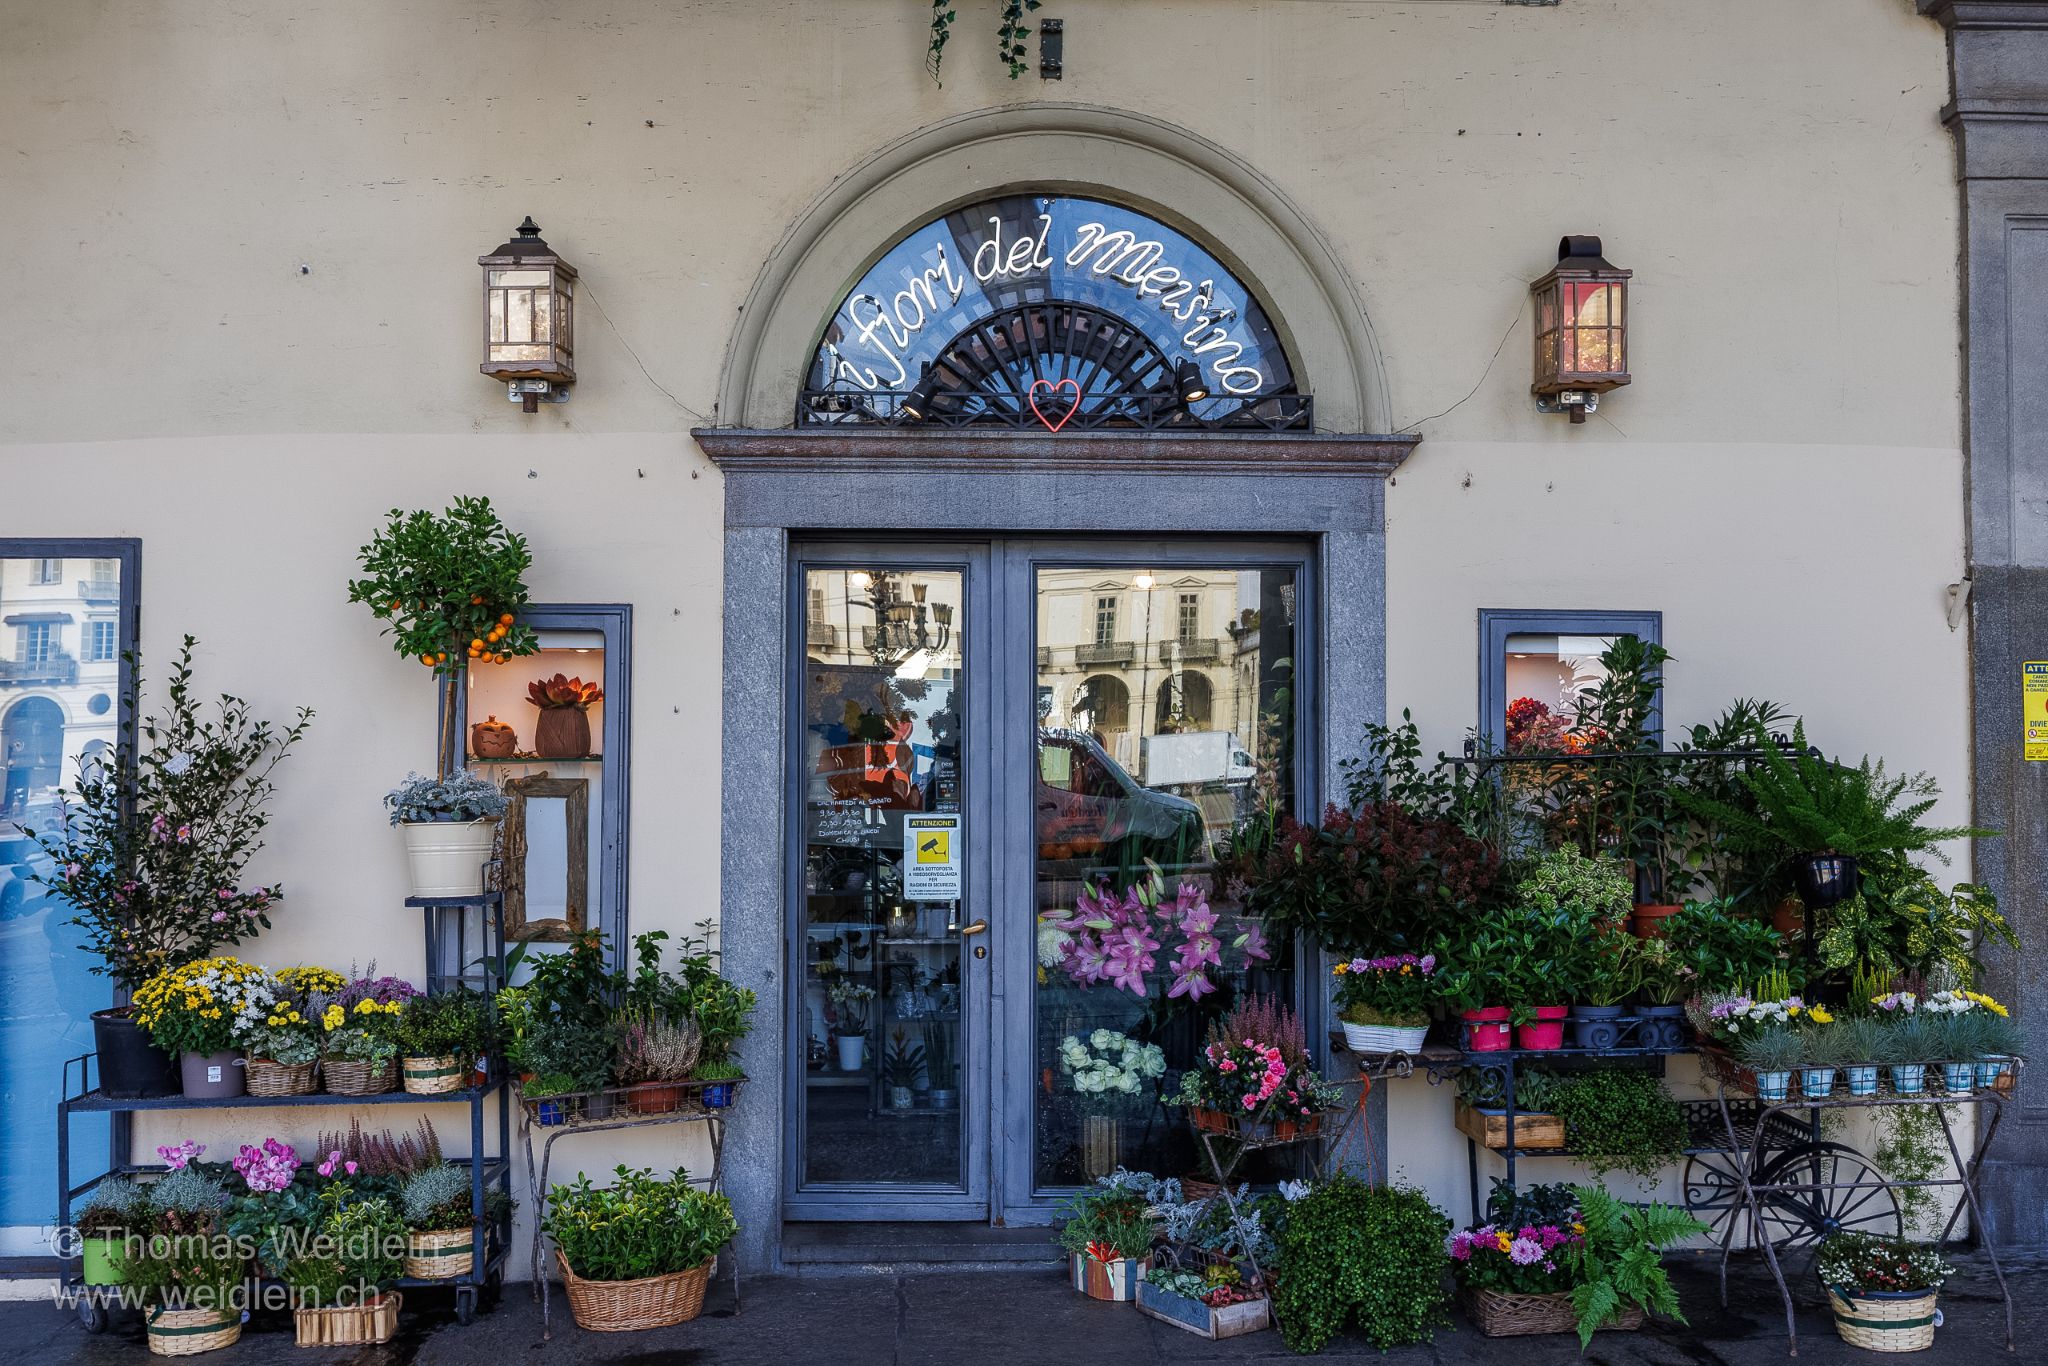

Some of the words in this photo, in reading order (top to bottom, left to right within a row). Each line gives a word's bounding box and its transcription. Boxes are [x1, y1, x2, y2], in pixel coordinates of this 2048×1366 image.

[974, 215, 1054, 281] del
[849, 242, 964, 388] fiori
[830, 344, 878, 390] i
